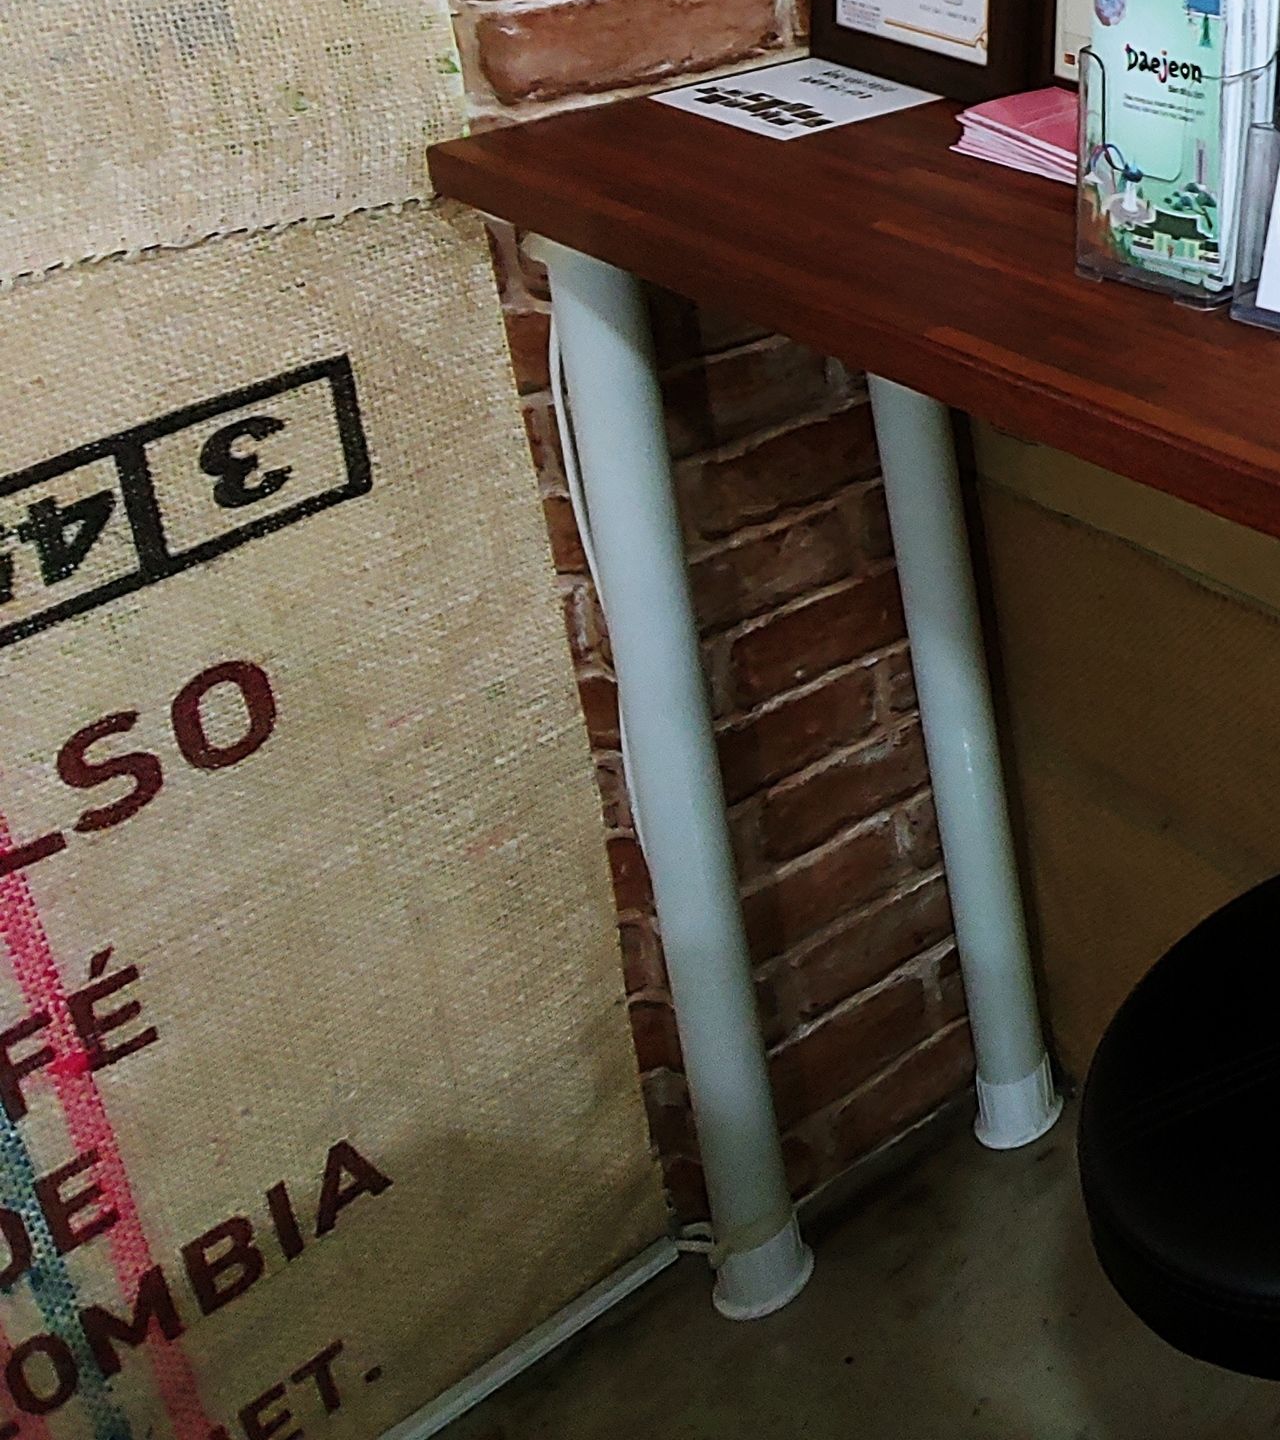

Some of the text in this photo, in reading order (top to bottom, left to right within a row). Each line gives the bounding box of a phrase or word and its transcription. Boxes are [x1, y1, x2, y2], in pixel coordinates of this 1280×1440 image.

[1125, 43, 1203, 83] Daejeon
[3, 1140, 394, 1418] OMBIA
[212, 1339, 384, 1440] ET.
